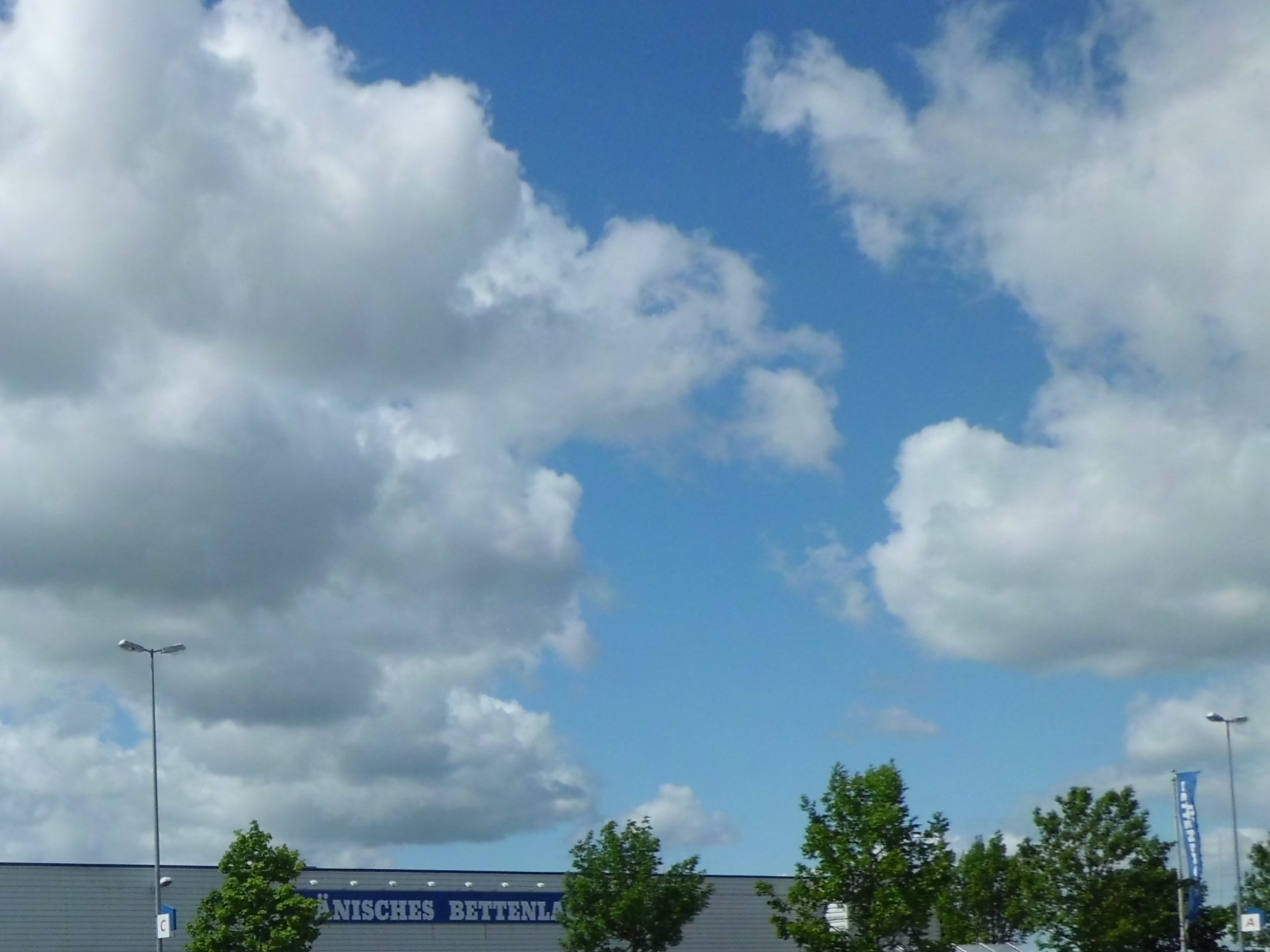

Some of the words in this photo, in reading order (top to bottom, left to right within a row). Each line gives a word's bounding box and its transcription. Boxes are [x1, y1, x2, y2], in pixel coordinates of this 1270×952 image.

[314, 893, 435, 921] ÄNISCHES
[160, 919, 167, 932] C
[1245, 918, 1255, 927] A
